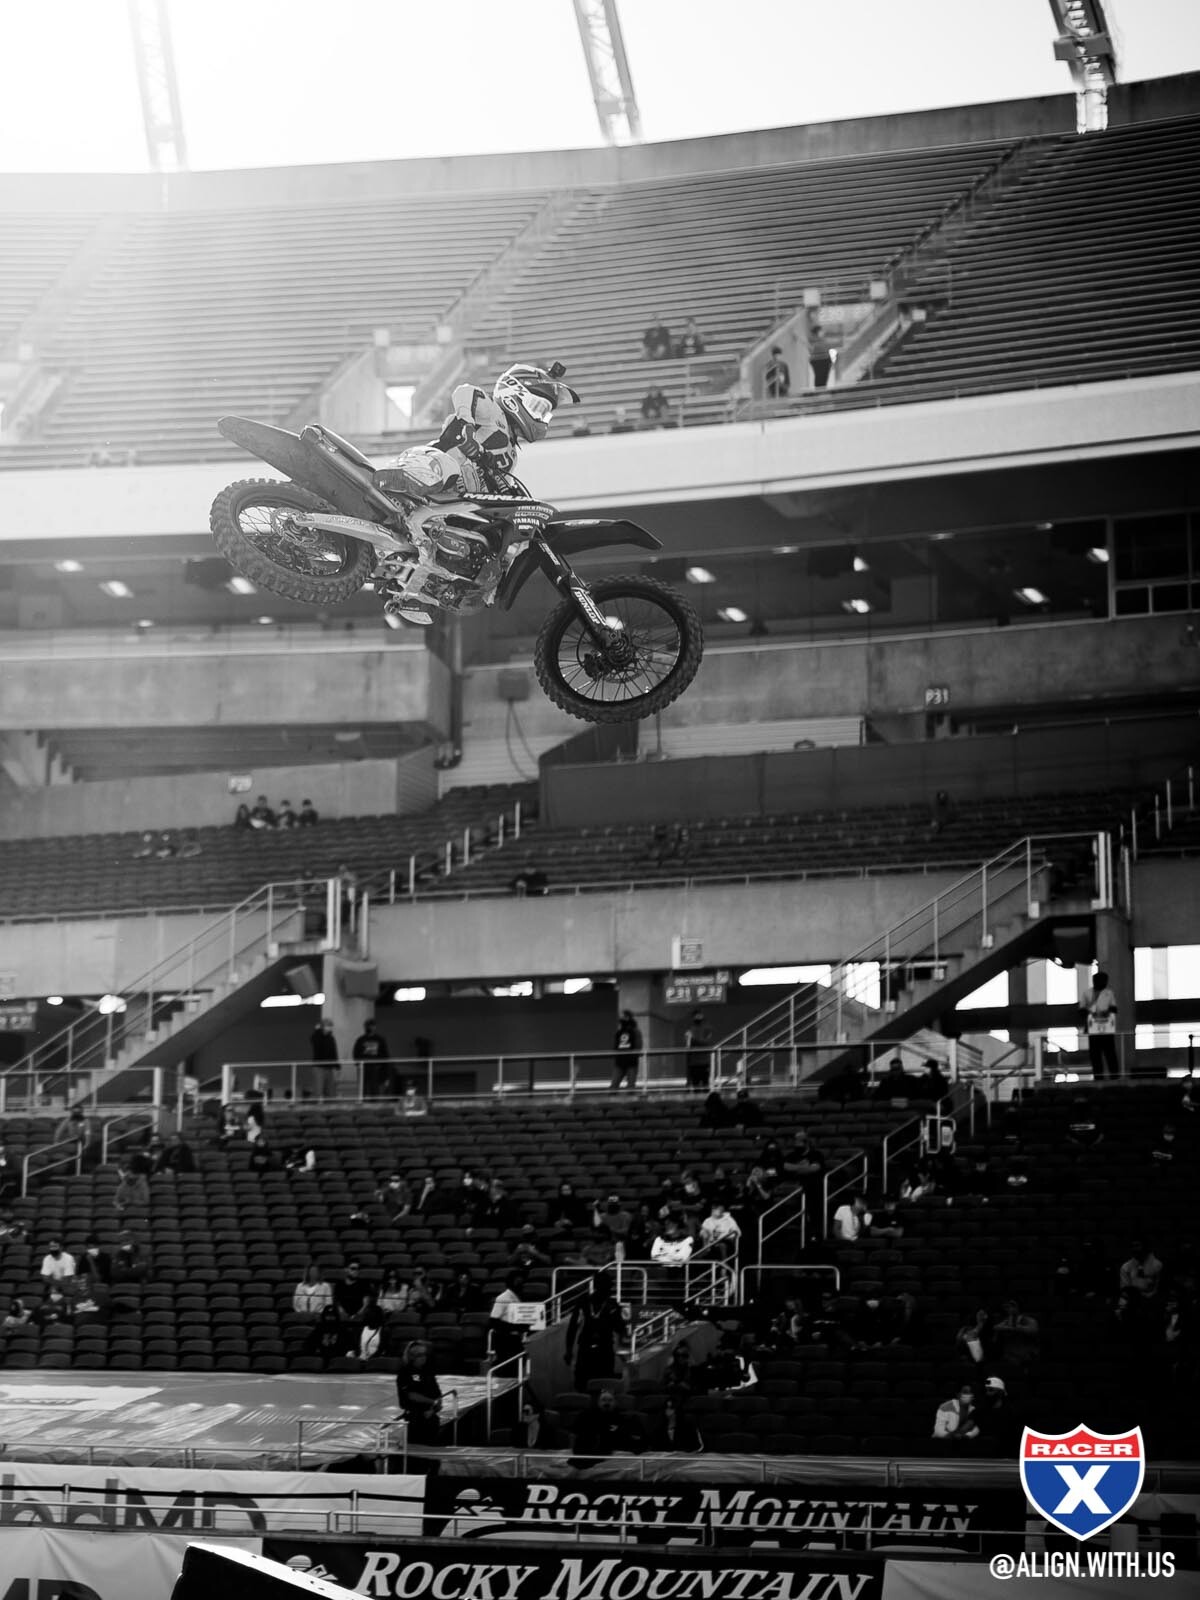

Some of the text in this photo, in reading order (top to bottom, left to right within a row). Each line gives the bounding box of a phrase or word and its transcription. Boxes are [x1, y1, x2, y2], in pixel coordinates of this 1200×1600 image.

[574, 590, 601, 624] DUNLOP
[516, 1484, 979, 1538] ROCKY MOUNTAIN
[351, 1551, 874, 1600] ROCKY MOUNTAIN
